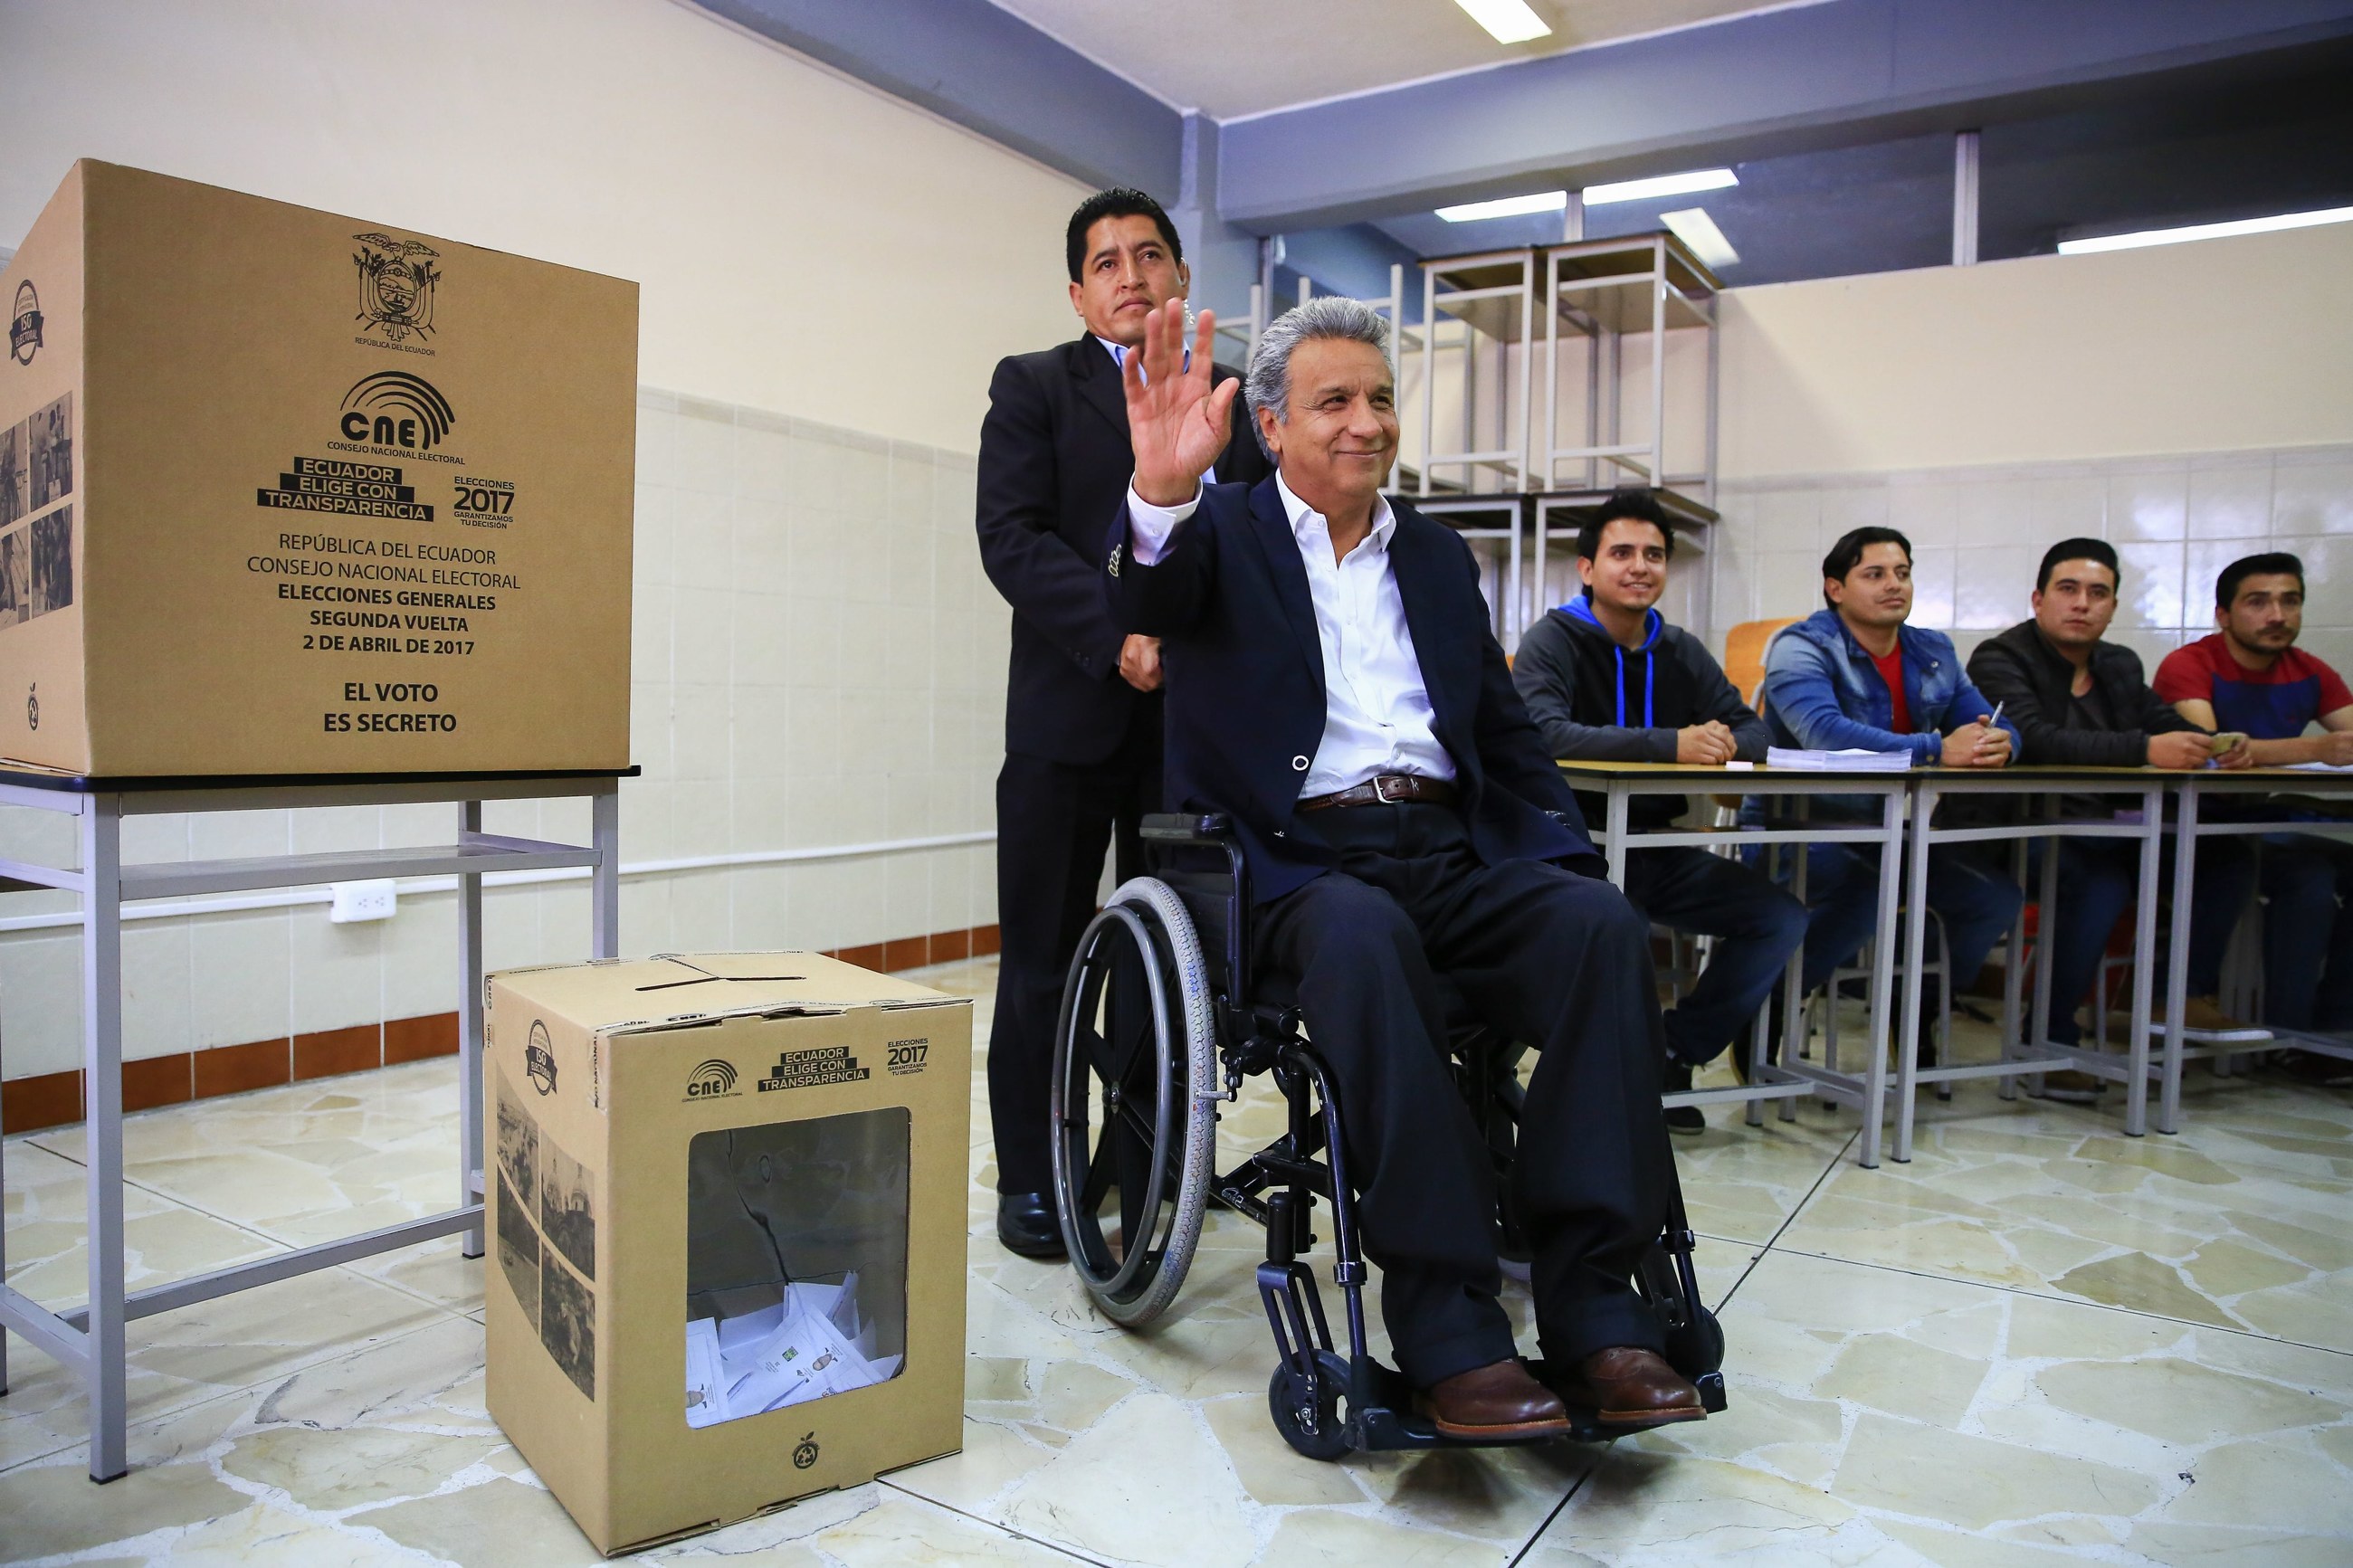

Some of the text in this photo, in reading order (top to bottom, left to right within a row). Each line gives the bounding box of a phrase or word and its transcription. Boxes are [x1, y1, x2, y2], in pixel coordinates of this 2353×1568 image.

[20, 313, 33, 331] ISO
[15, 329, 38, 347] ELECTORAL
[356, 337, 435, 356] REPÚBLICA DEL ECUADOR
[328, 442, 465, 465] CONSEJO NACIONAL ELECTORAL
[302, 460, 395, 482] ECUADOR
[300, 478, 396, 499] ELIGE CON
[454, 476, 514, 490] ELECCIONES
[266, 491, 426, 520] TRANSPARENCIA
[454, 487, 514, 515] 2017
[454, 511, 514, 523] GARANTIZAMOS
[472, 519, 507, 529] DECISIÓN
[280, 533, 496, 565] REPÚBLICA DEL ECUADOR
[247, 556, 521, 590] CONSEJO NACIONAL ELECTORAL
[279, 583, 496, 611] ELECCIONES GENERALES
[310, 610, 469, 632] SEGUNDA VUELTA
[303, 635, 474, 655] 2 DE ABRIL DE 2017
[344, 682, 438, 702] EL VOTO
[324, 713, 456, 733] ES SECRETO
[888, 1038, 929, 1048] ELECCIONES
[536, 1049, 547, 1066] ISO
[786, 1048, 843, 1064] ECUADOR
[888, 1045, 929, 1066] 2017
[530, 1061, 552, 1082] ELECTORAL
[784, 1060, 845, 1077] ELIGE CON
[888, 1062, 927, 1071] GARANTIZAMOS
[762, 1069, 865, 1091] TRANSPARENCIA
